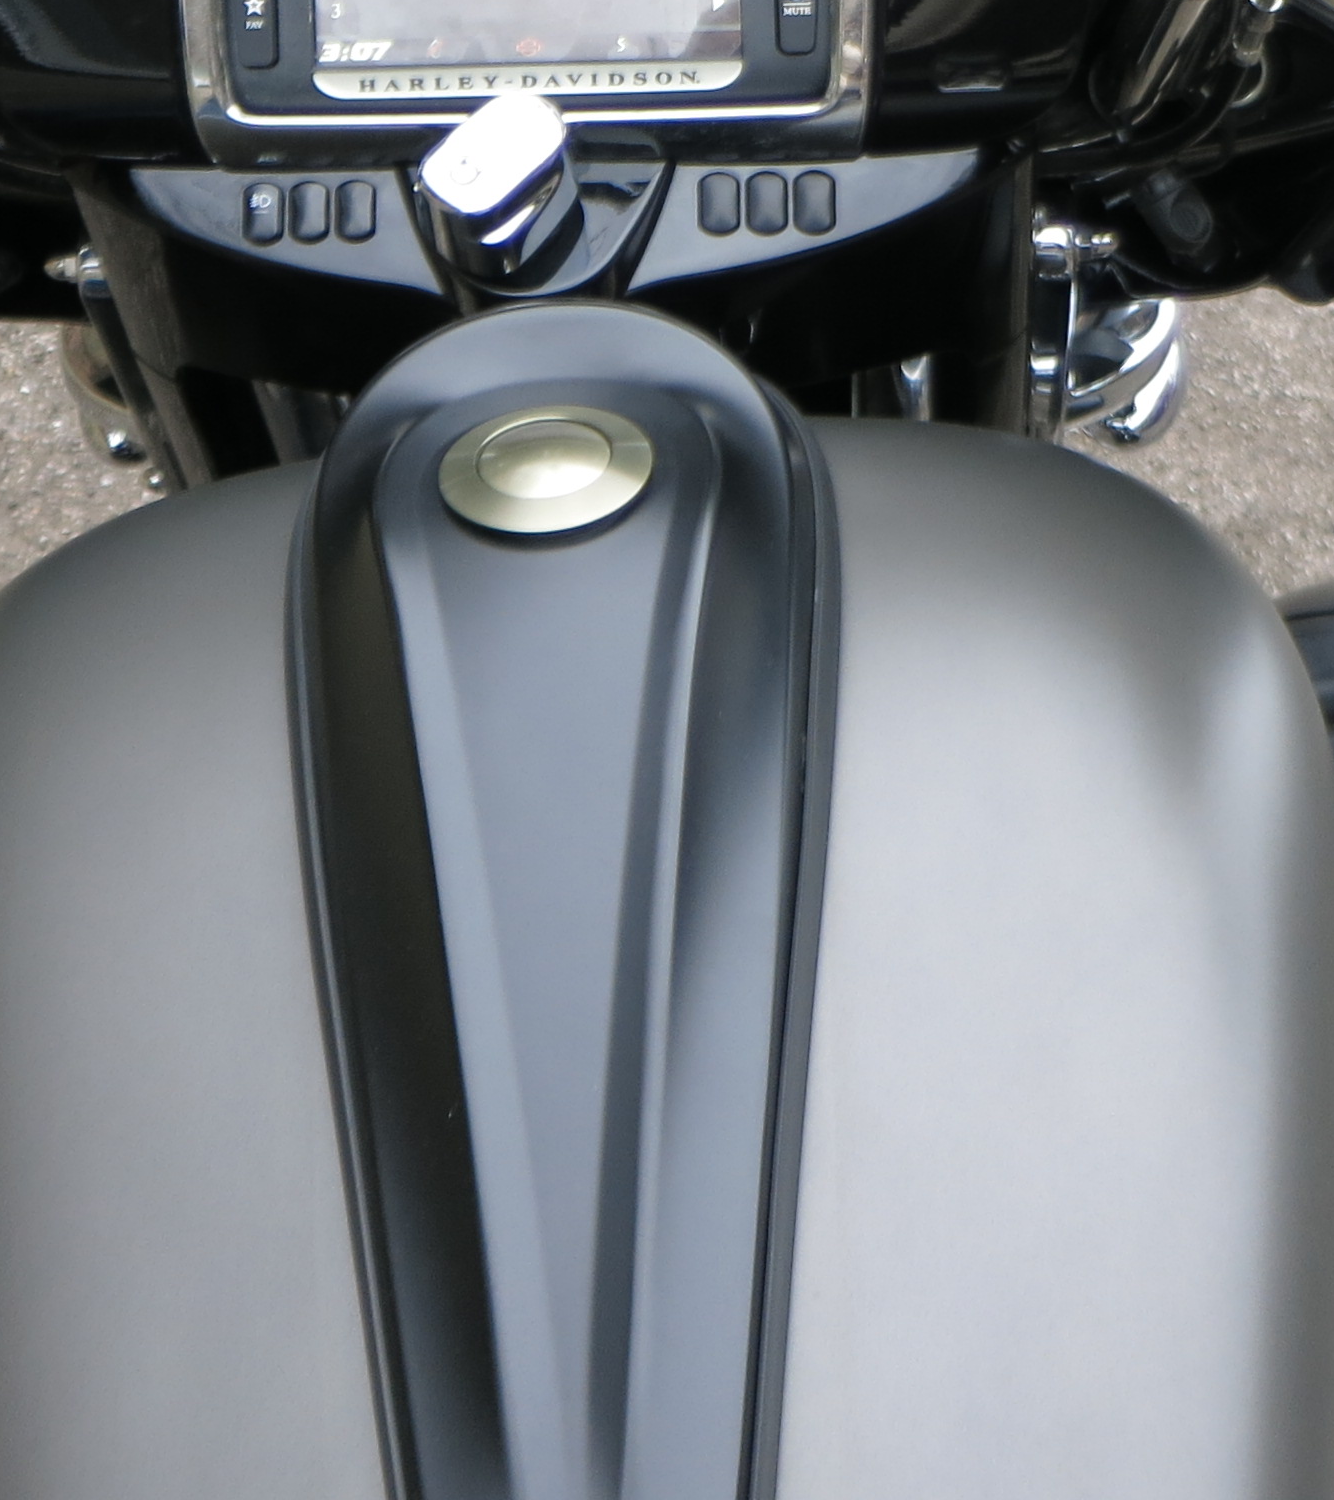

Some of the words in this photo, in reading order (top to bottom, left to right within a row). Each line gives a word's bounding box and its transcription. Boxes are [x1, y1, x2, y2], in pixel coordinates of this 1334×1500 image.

[330, 2, 343, 19] 3
[781, 7, 813, 17] MUTE
[245, 20, 264, 30] FAV
[319, 40, 391, 62] 3:07
